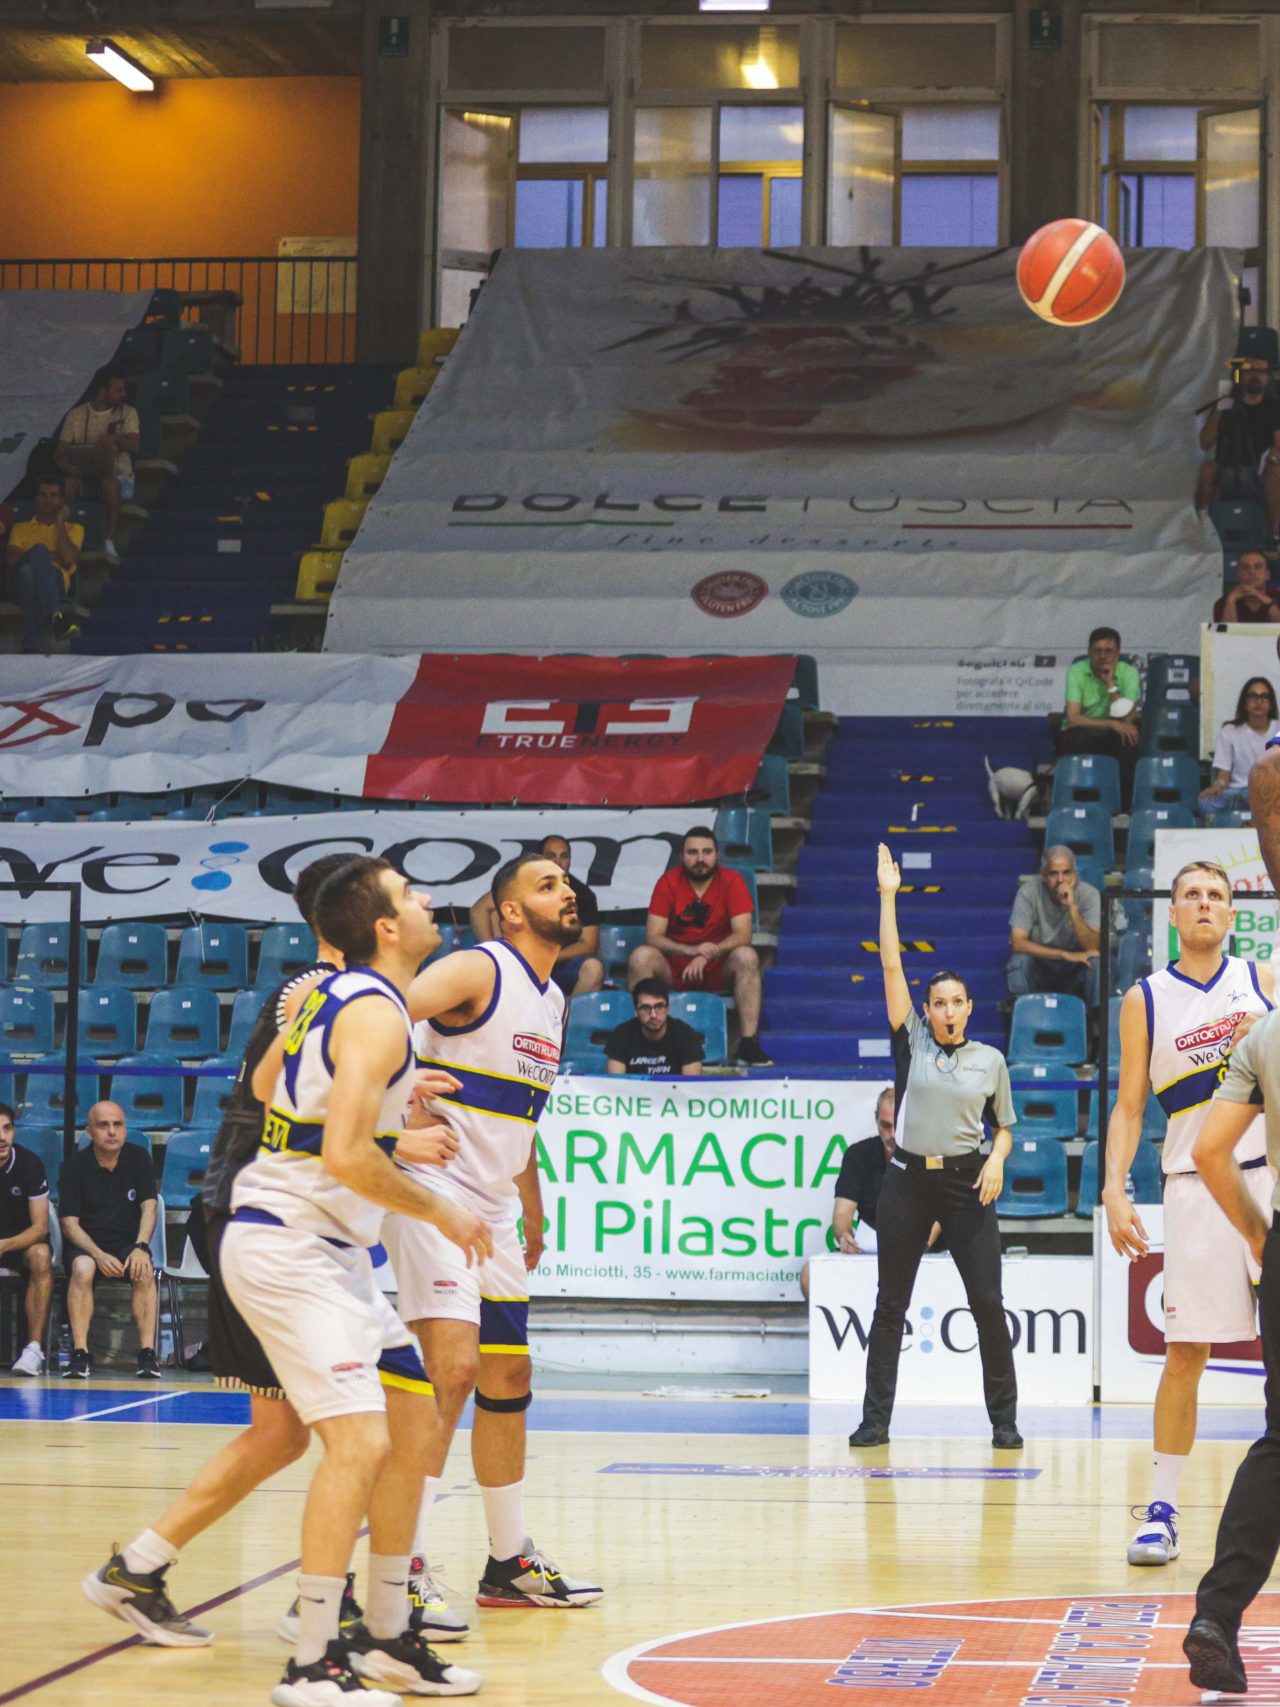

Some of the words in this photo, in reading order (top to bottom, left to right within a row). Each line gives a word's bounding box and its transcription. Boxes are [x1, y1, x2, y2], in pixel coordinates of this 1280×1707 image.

[452, 493, 769, 512] DOLCE
[660, 1099, 679, 1118] A
[688, 1098, 836, 1120] DOMICILIO
[633, 1265, 652, 1279] 35
